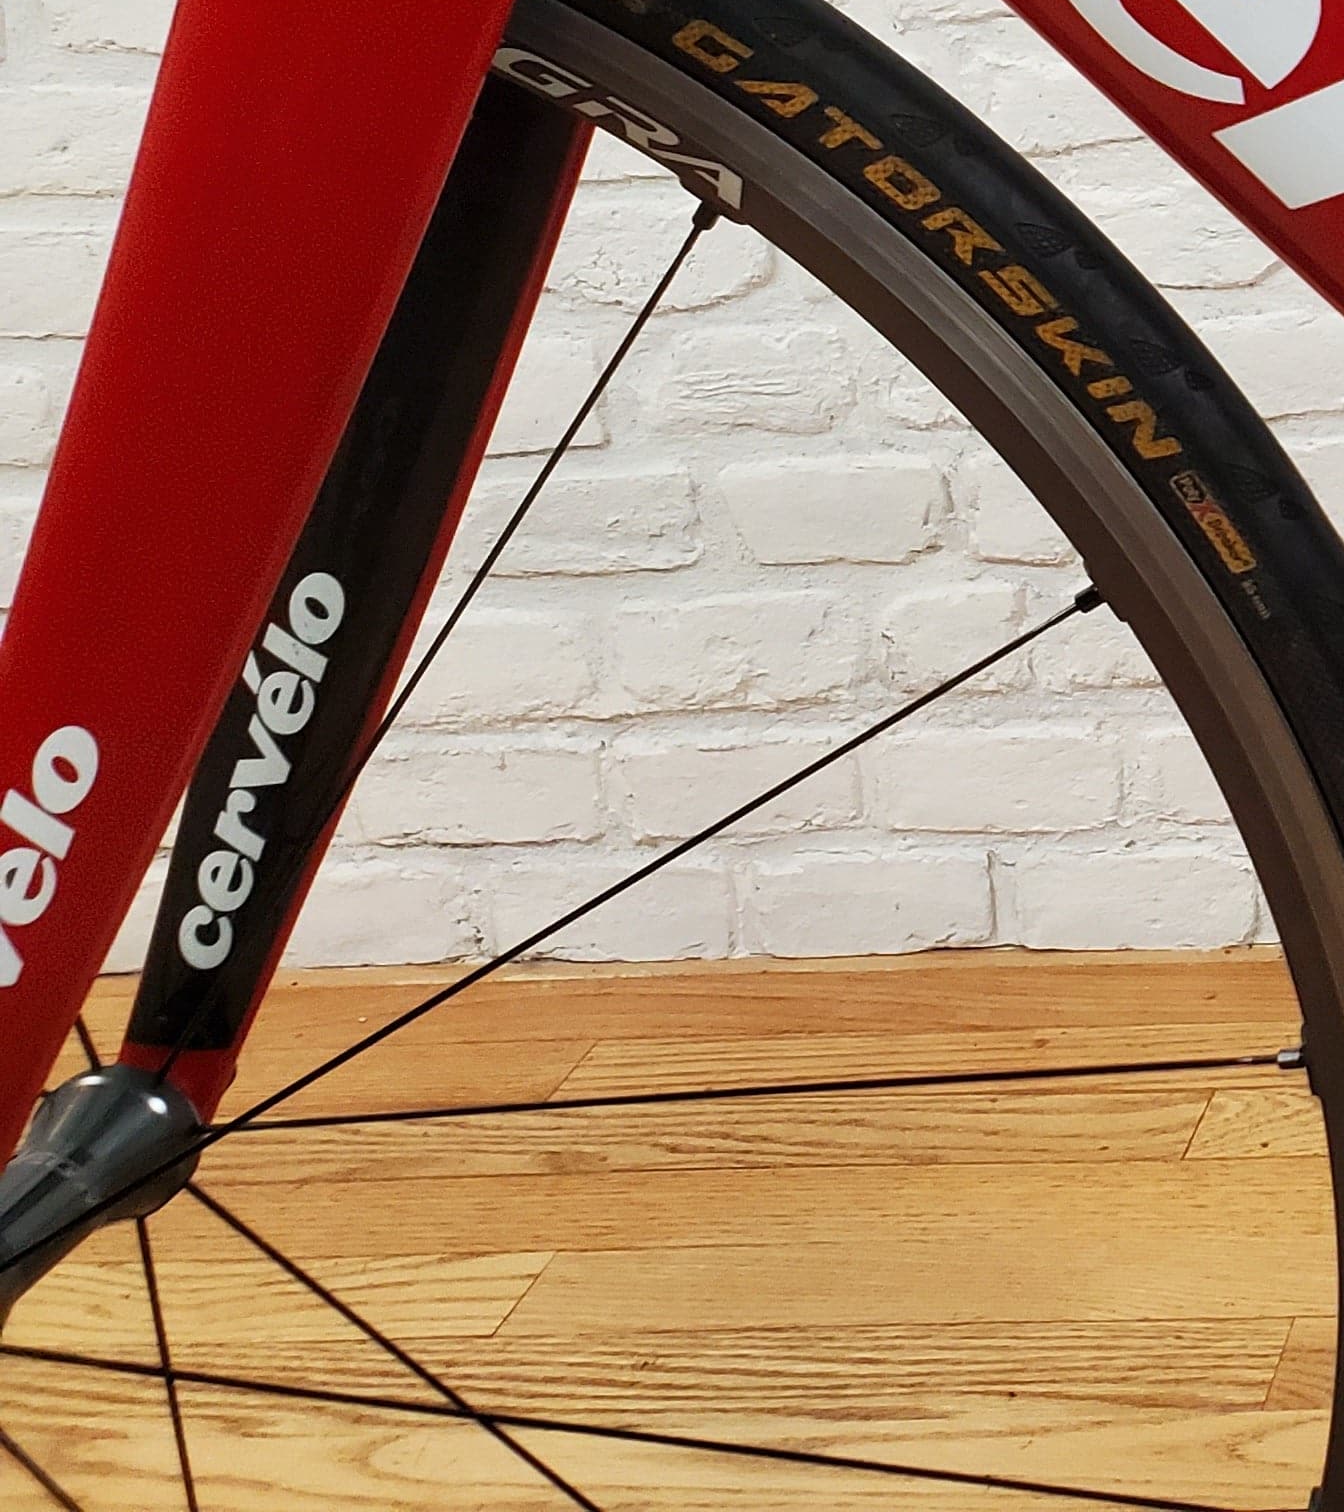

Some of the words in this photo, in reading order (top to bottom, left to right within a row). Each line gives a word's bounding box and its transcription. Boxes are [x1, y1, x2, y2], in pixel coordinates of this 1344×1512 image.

[491, 46, 744, 211] GRA
[671, 18, 1183, 462] GATORSKIN
[178, 571, 346, 971] cervélo
